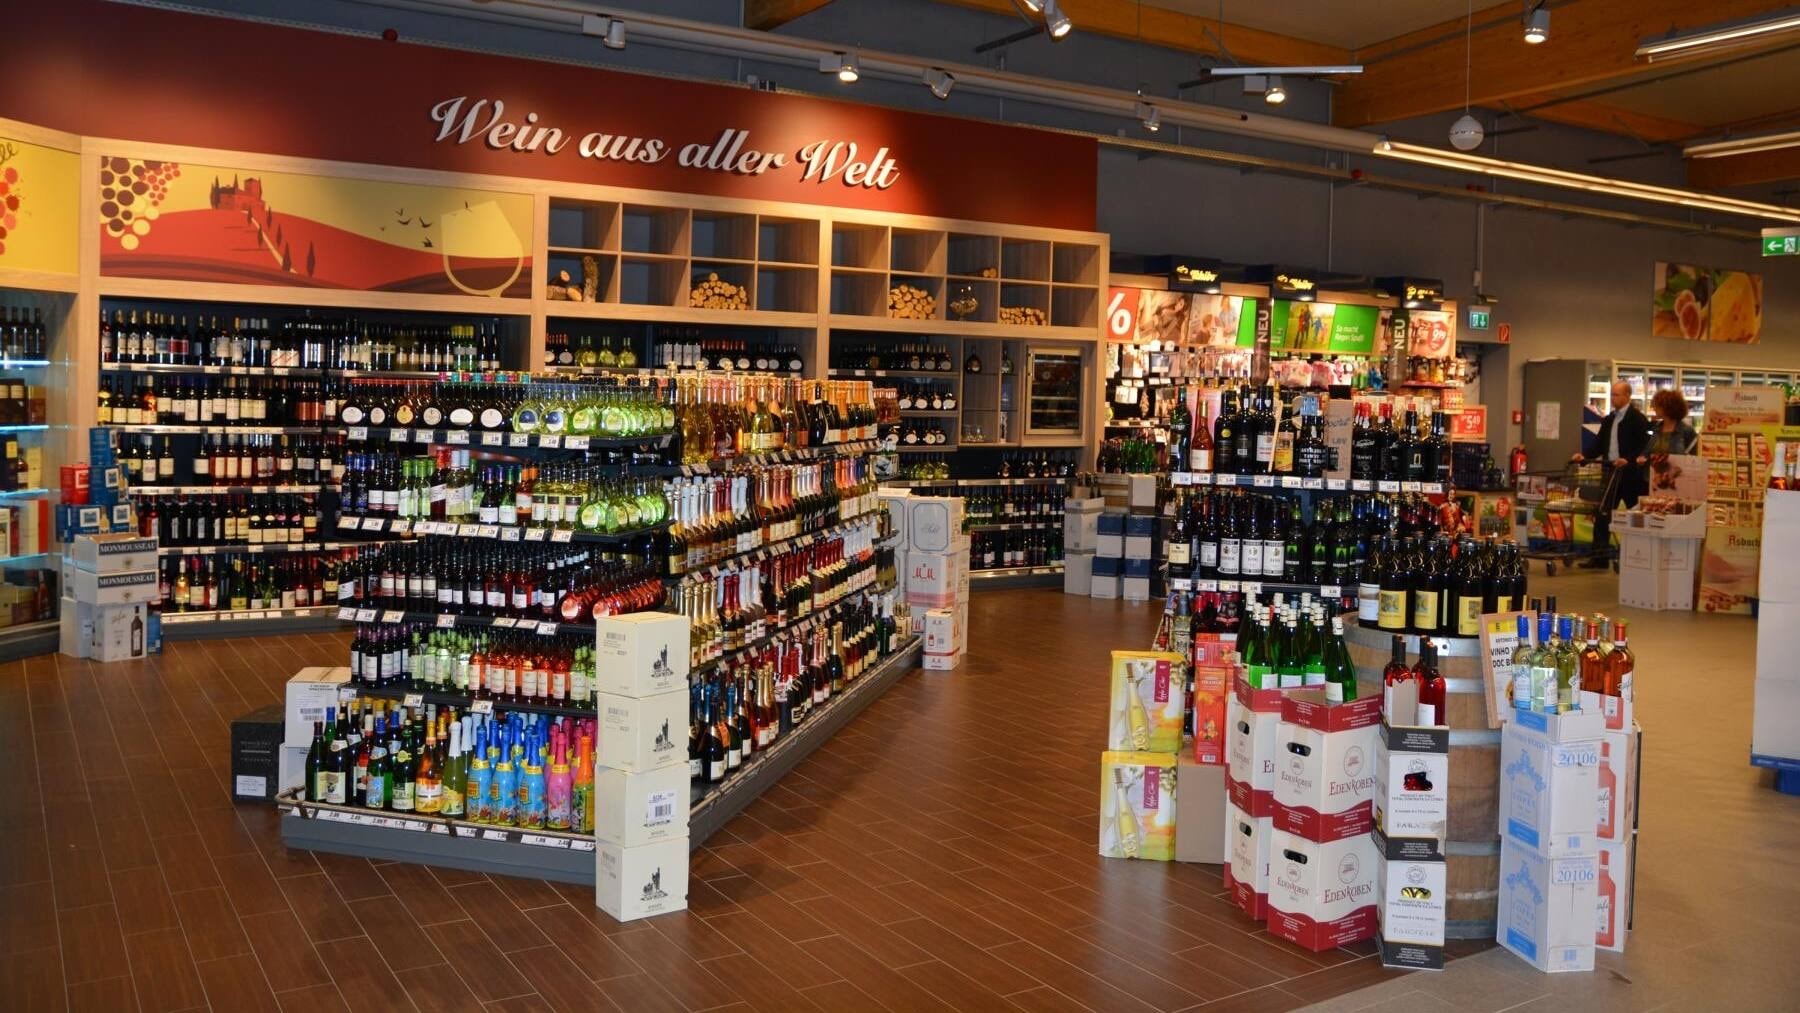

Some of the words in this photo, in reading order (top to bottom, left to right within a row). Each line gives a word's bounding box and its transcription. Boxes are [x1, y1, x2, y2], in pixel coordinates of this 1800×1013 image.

[431, 96, 570, 154] Wein
[579, 132, 670, 163] aus
[678, 128, 790, 175] aller
[796, 139, 900, 189] Welt
[1257, 310, 1269, 342] NEU
[1394, 319, 1406, 350] NEU
[100, 542, 157, 554] MONMOUSSEAU
[99, 573, 155, 585] MONMOUSSEAU
[1490, 646, 1509, 656] VINHO
[1559, 752, 1597, 766] 20106
[1557, 869, 1594, 882] 20106
[1323, 880, 1373, 903] EDENKOBEN
